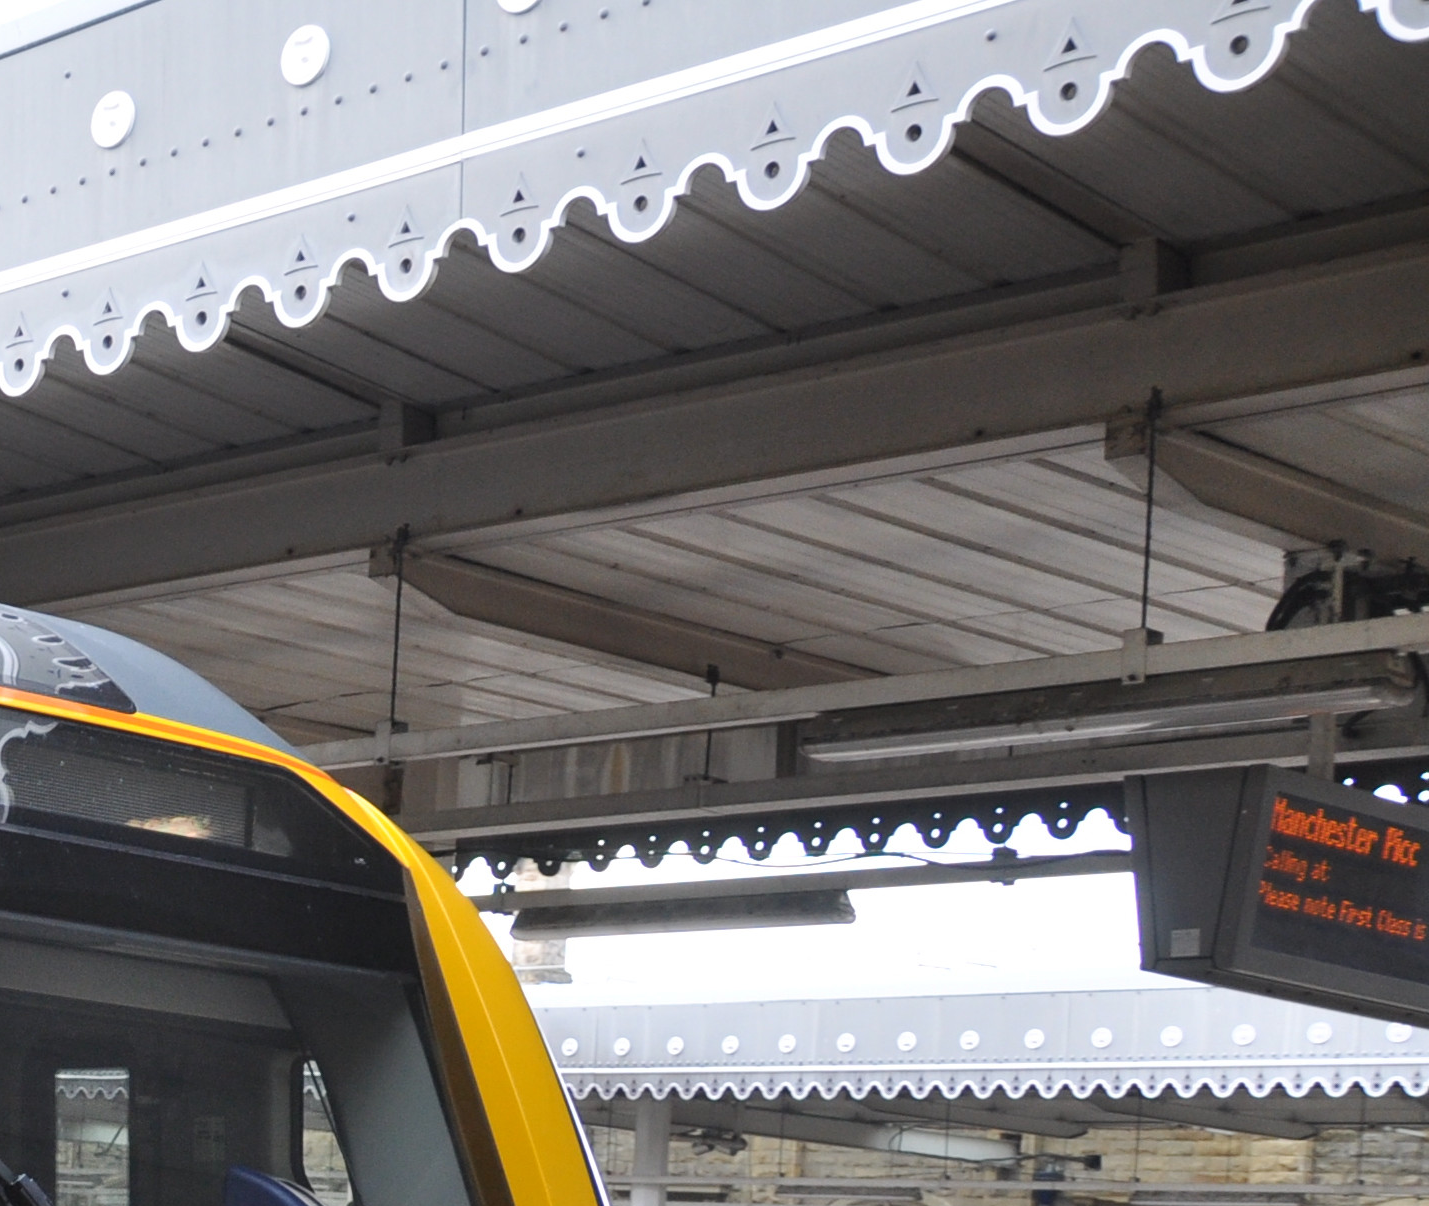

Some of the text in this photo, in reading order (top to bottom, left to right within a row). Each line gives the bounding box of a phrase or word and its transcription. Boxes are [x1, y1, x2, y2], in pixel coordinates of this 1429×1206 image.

[1271, 797, 1421, 867] Manchester Picc
[1258, 880, 1301, 911] Please
[1303, 896, 1336, 920] note
[1339, 899, 1373, 928] First
[1375, 909, 1413, 937] Class
